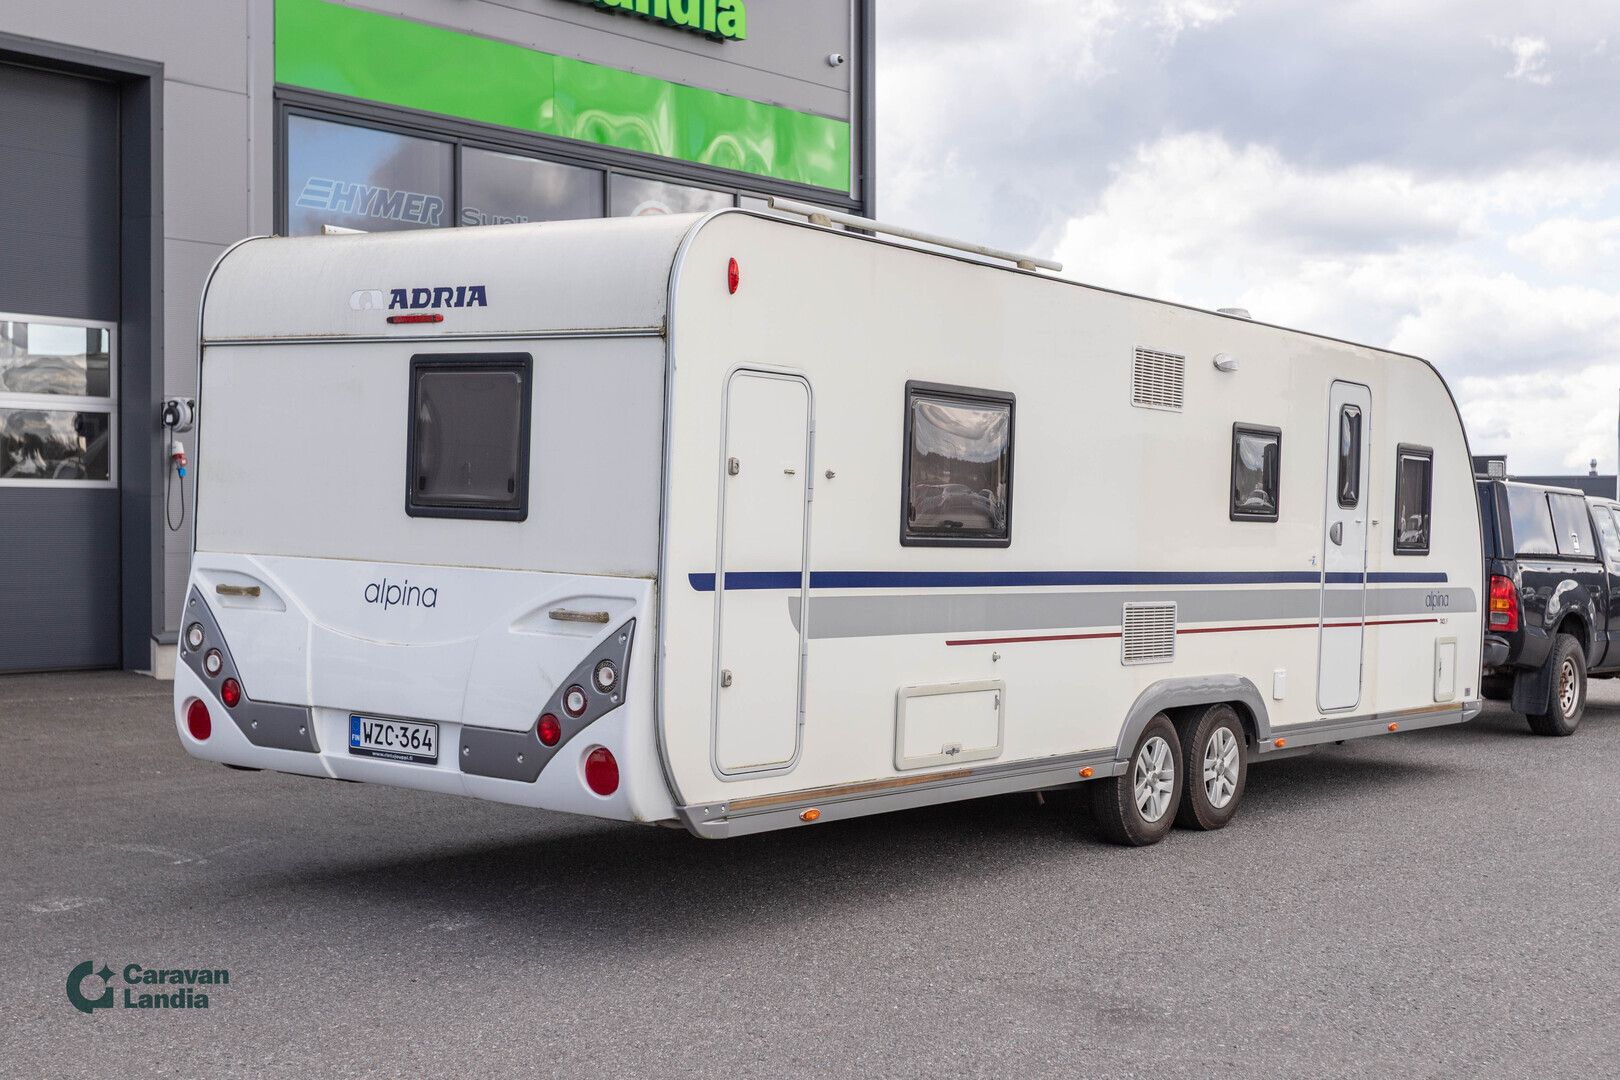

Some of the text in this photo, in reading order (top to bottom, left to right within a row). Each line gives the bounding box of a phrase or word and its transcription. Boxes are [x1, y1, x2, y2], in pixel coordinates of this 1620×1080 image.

[595, 0, 747, 40] dia
[327, 181, 444, 226] HYMER
[388, 285, 488, 310] ADRIA
[364, 577, 438, 611] alpina
[1425, 590, 1449, 611] alpina
[363, 721, 433, 752] WZC-364
